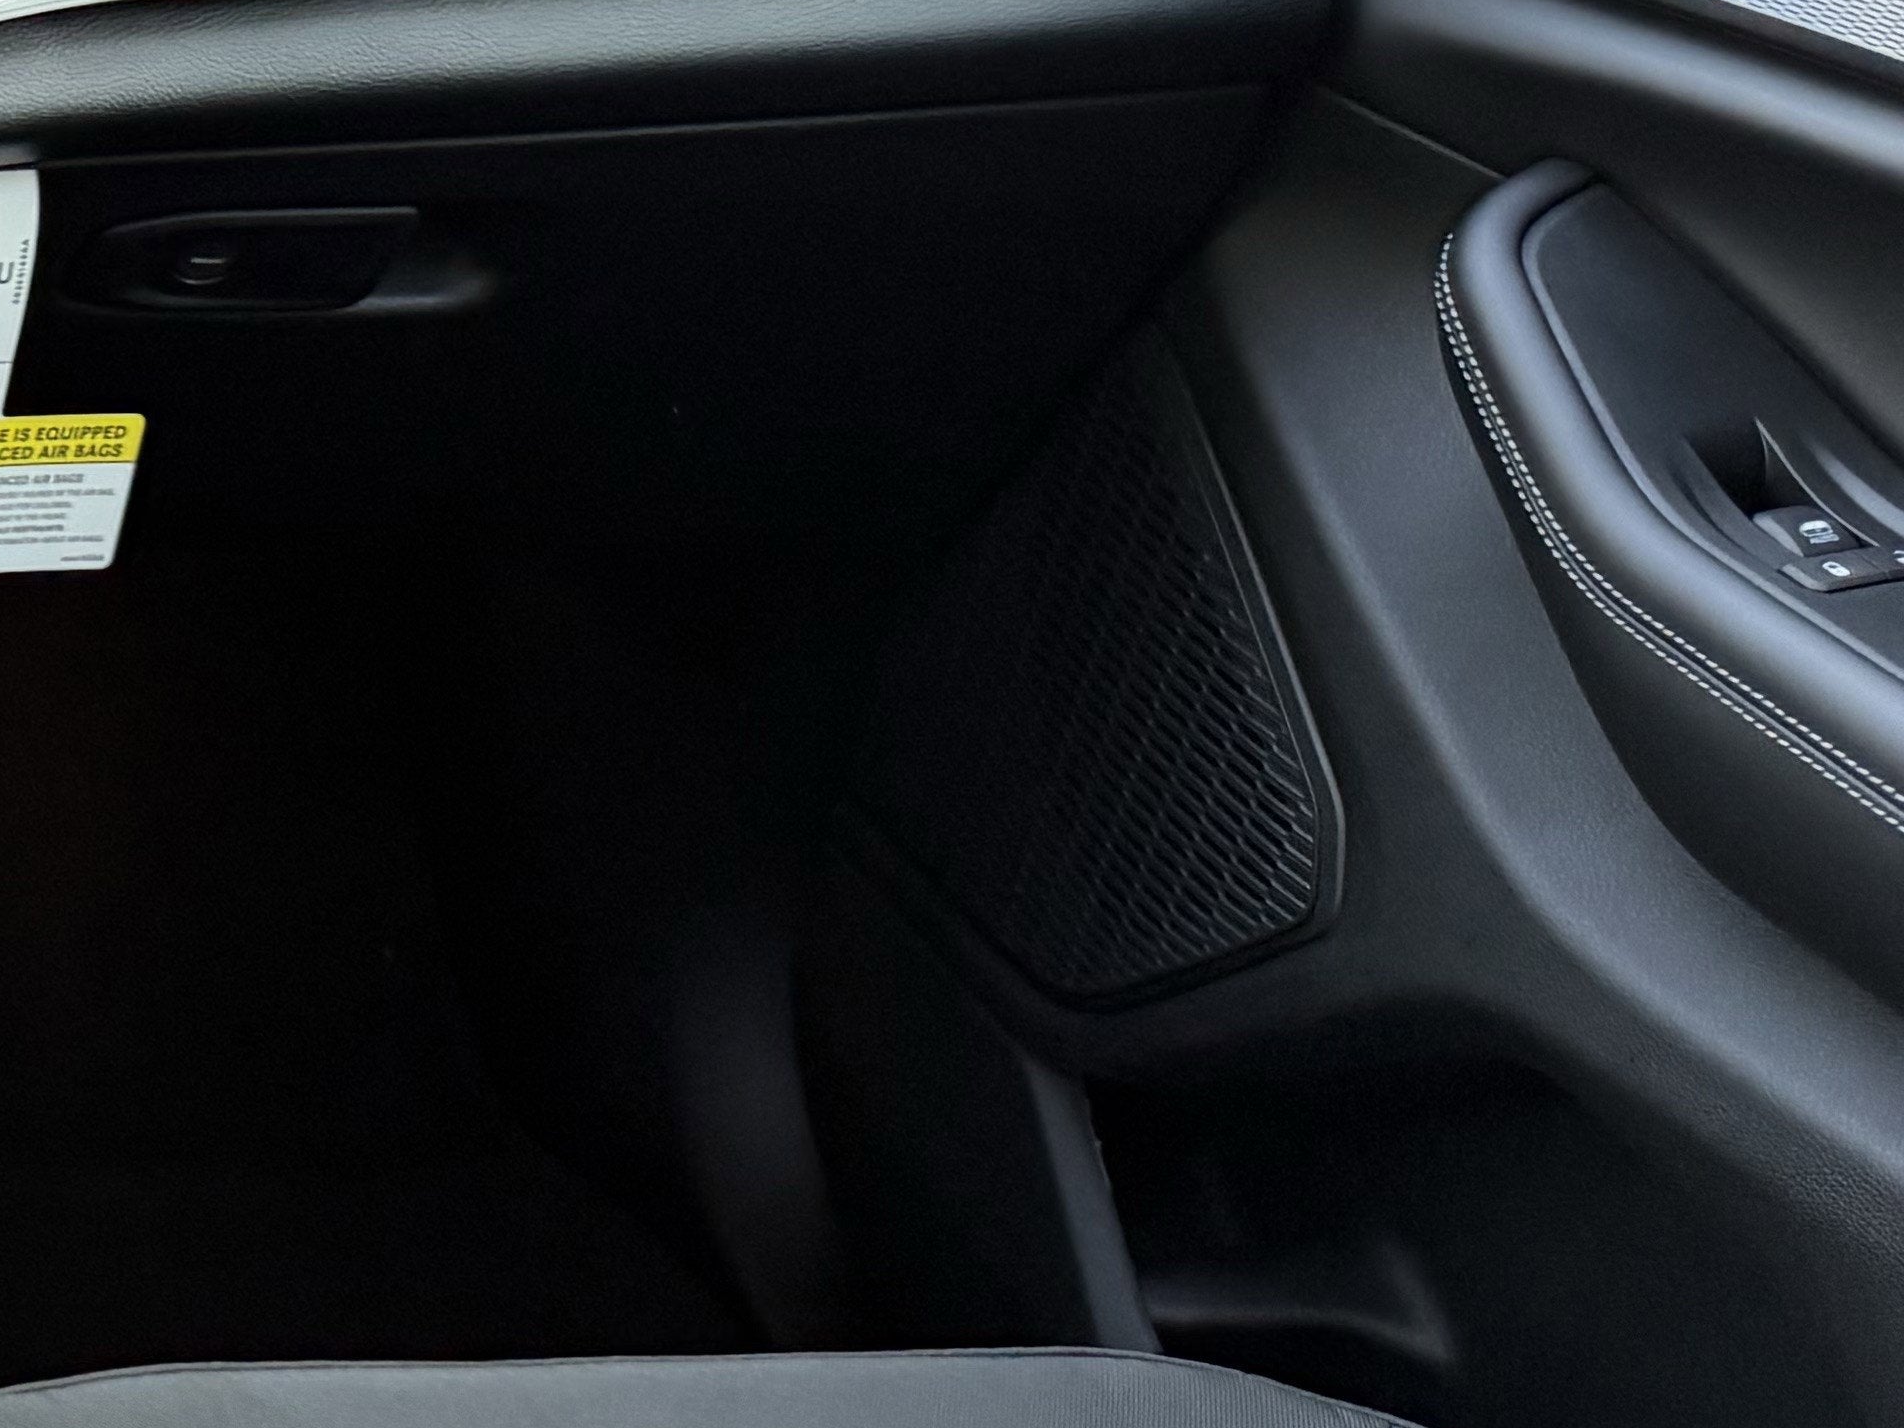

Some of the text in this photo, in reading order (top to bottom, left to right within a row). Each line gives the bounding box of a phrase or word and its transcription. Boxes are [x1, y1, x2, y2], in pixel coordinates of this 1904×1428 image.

[14, 428, 29, 442] IS
[35, 425, 128, 442] EQUIPPED
[40, 444, 70, 460] AIR
[74, 443, 123, 458] BAGS
